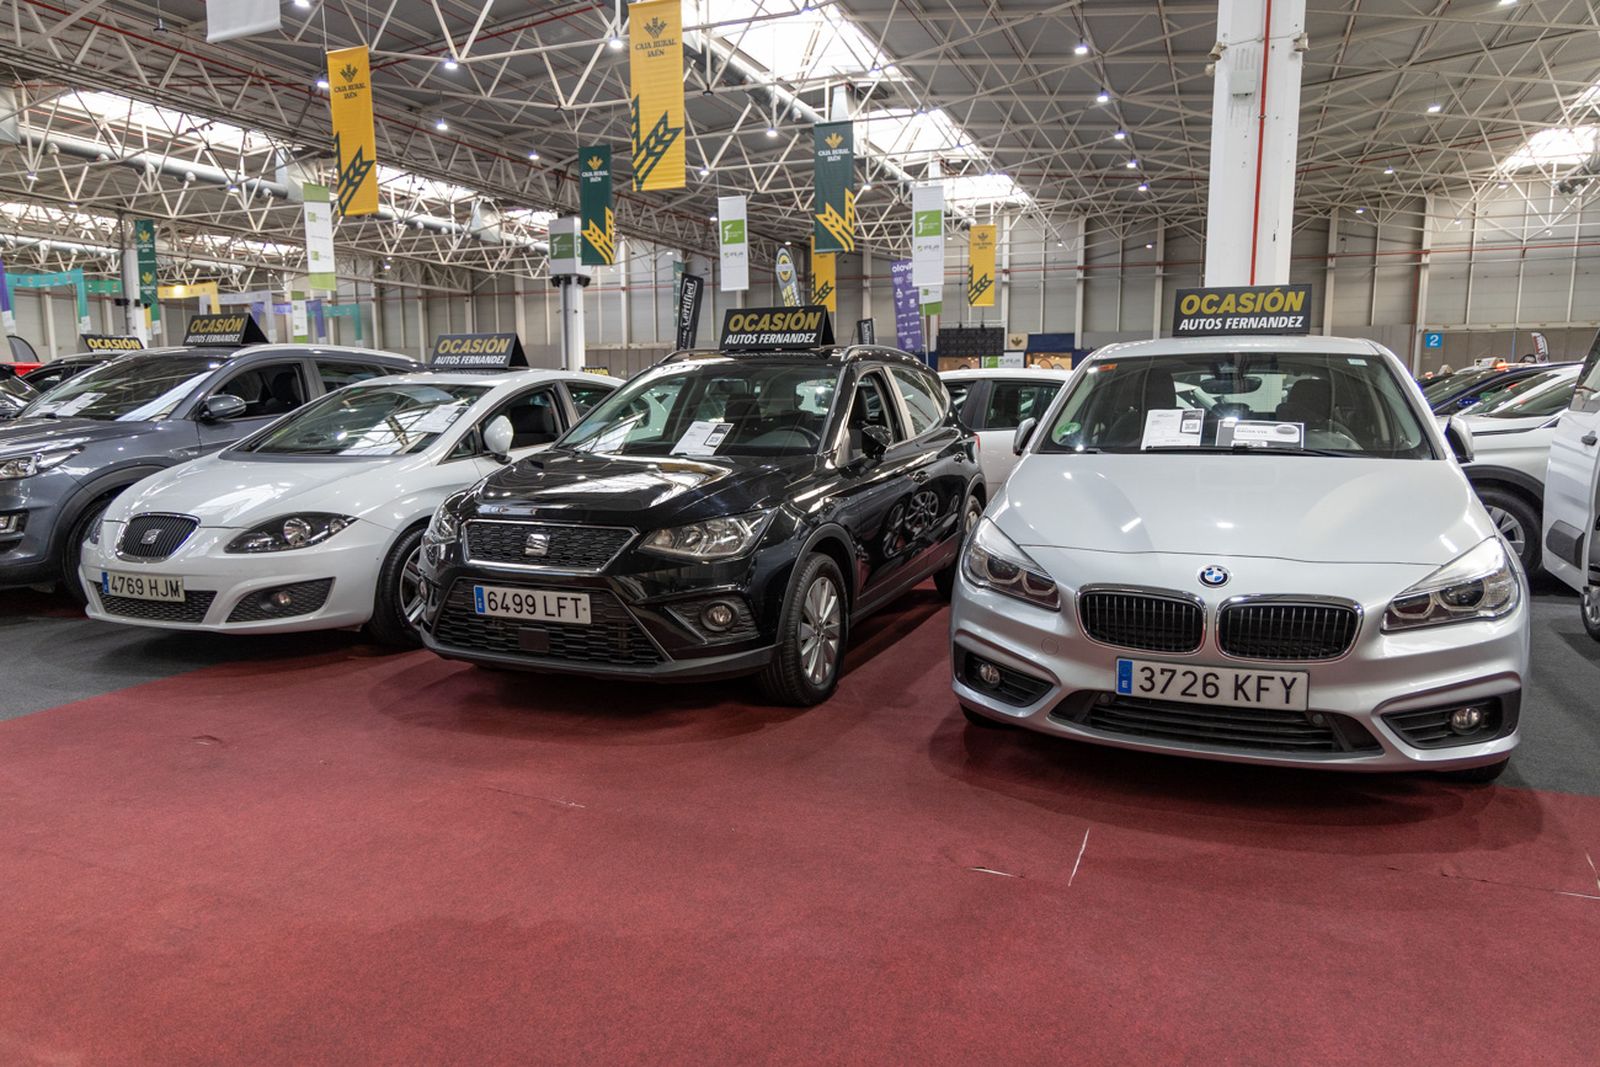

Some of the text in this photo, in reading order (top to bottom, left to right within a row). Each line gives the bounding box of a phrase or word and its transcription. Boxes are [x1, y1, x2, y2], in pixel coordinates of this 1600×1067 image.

[653, 39, 677, 48] RURAL
[1180, 287, 1305, 315] OCASIÓN
[190, 315, 244, 333] OCASIÓN
[728, 307, 821, 332] OCASIÓN
[1179, 315, 1304, 330] AUTOS FERNANDEZ
[87, 337, 141, 349] OCASIÓN
[186, 333, 241, 343] AUTOS FERNANDEZ
[437, 336, 511, 354] OCASIÓN
[725, 332, 817, 345] AUTOS FERNANDEZ
[1429, 335, 1439, 346] 2
[434, 355, 506, 365] AUTOS FERNANDEZ
[111, 576, 144, 595] 4769
[149, 579, 180, 597] HJM
[487, 591, 582, 619] 6499 LFT
[1138, 666, 1298, 705] 3726 KFY
